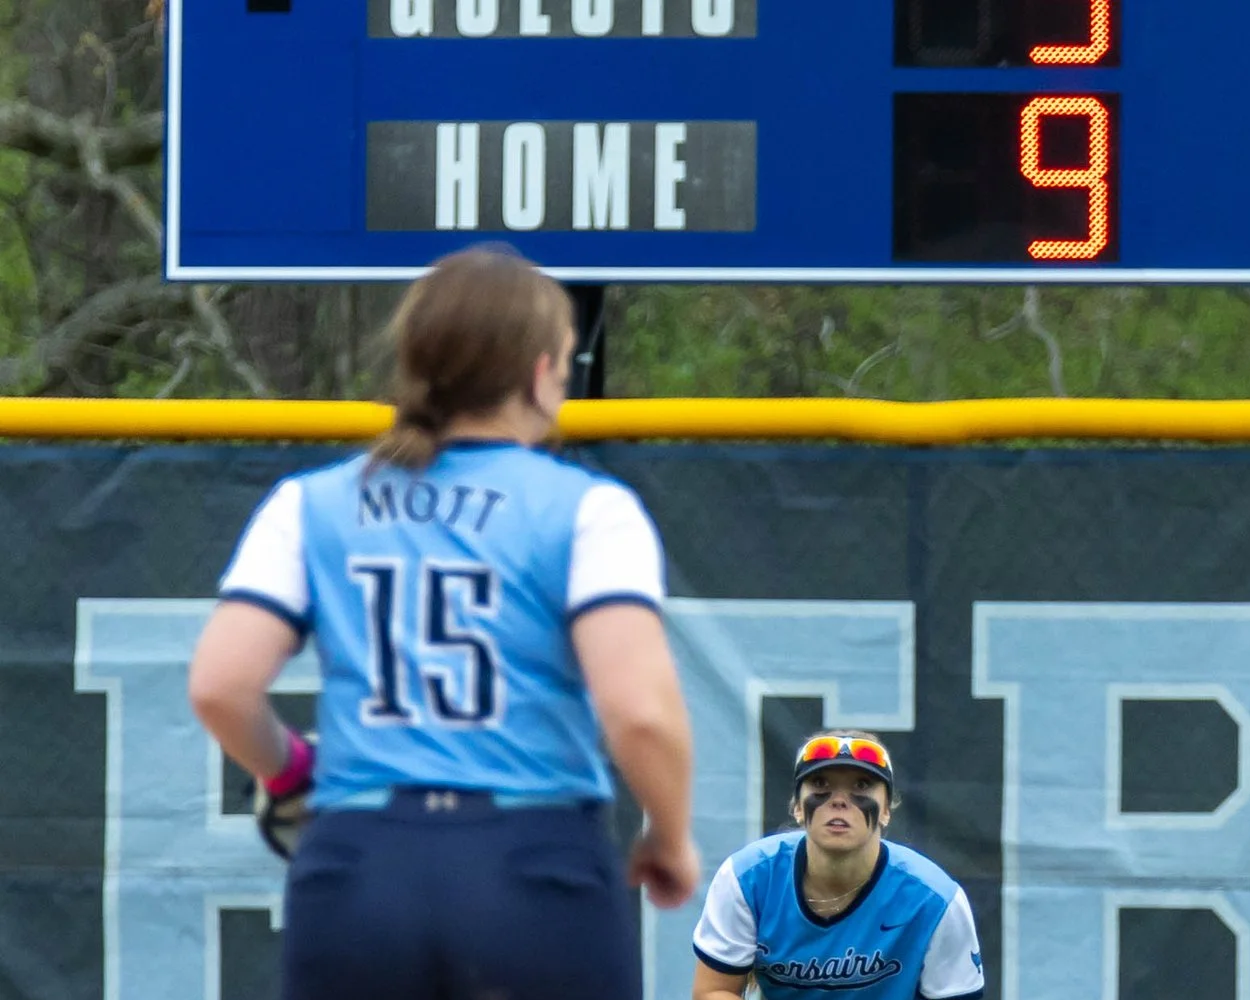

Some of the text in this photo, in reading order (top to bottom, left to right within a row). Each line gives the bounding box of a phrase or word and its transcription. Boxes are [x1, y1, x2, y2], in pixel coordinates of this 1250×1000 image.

[435, 122, 687, 230] HOME
[1020, 97, 1108, 259] 9
[358, 479, 507, 533] MOTT
[347, 557, 506, 727] 15
